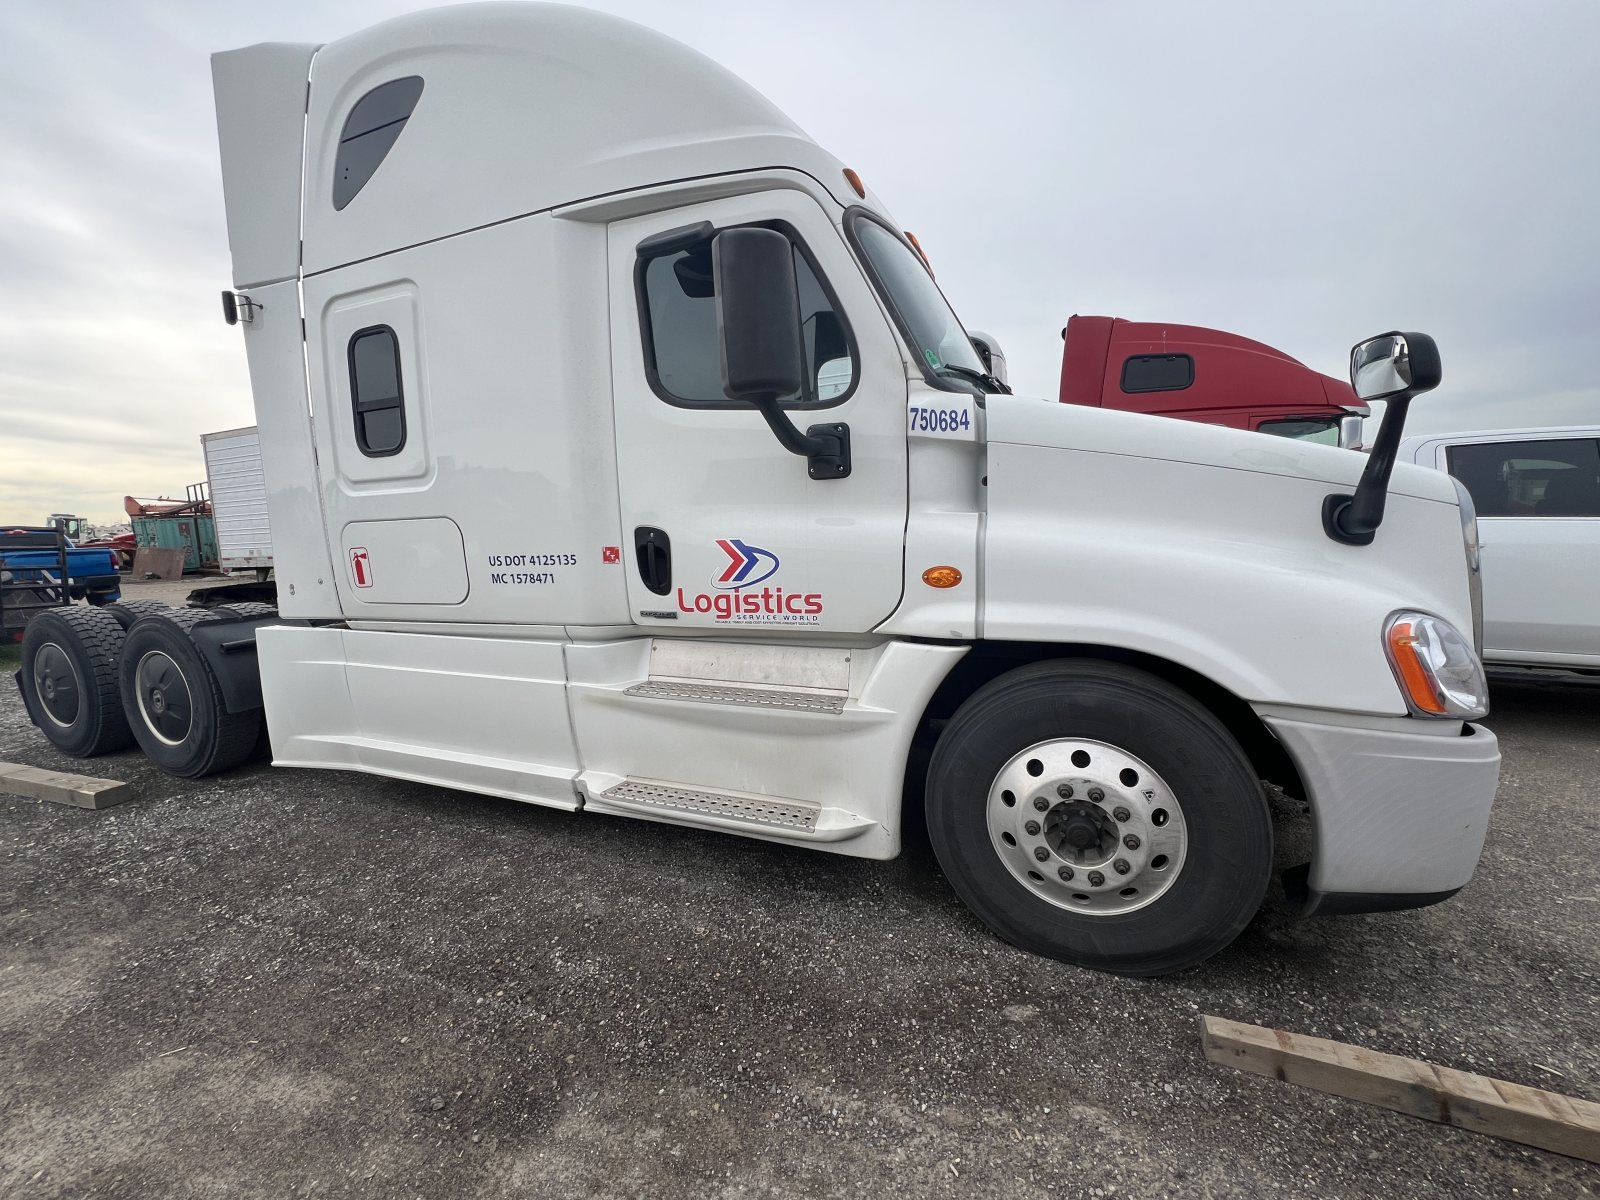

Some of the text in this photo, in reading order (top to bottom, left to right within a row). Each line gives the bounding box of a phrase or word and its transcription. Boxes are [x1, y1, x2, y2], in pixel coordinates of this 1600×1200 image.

[909, 407, 970, 432] 750684
[488, 554, 577, 566] US DOT 4125135
[491, 573, 555, 584] MC 1578471
[677, 586, 823, 619] Logistics
